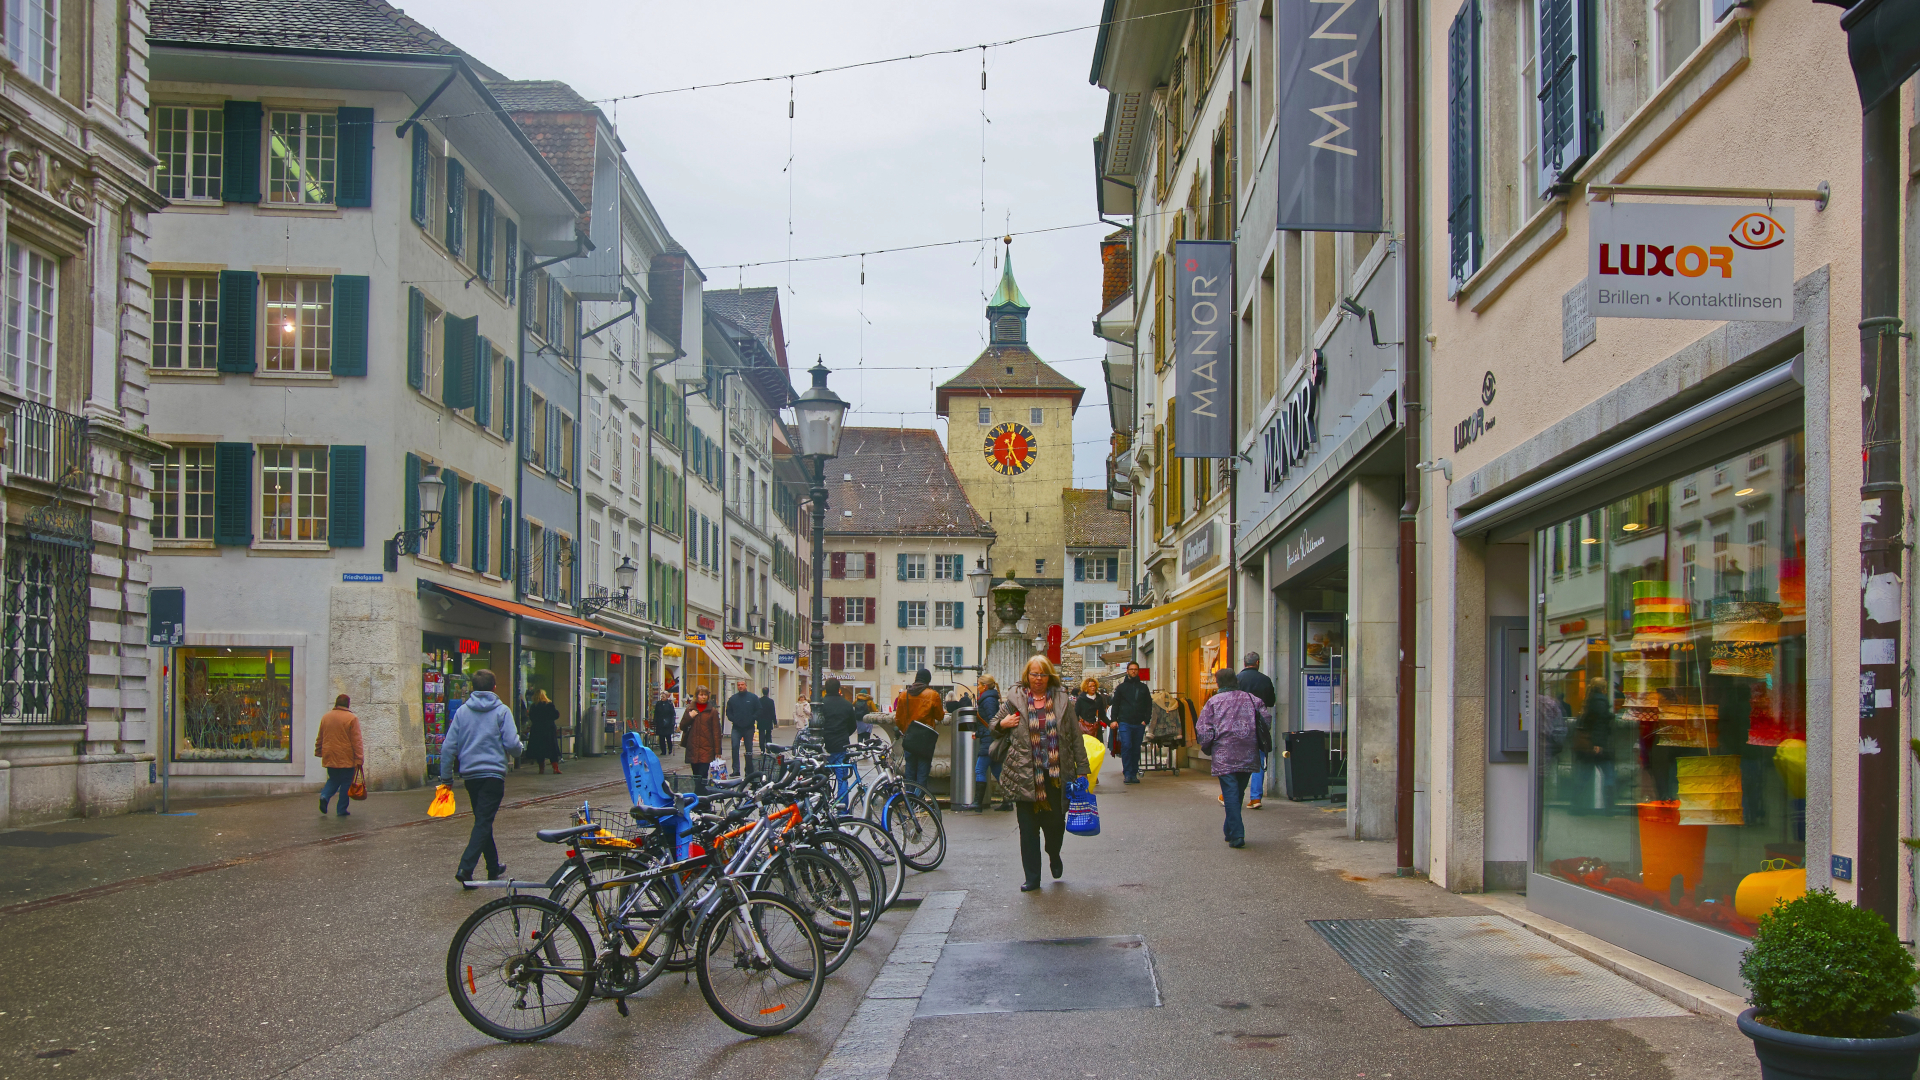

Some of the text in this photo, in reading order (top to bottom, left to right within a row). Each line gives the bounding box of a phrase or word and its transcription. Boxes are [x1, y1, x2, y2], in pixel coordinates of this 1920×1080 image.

[1599, 243, 1734, 278] LUXOR
[1598, 289, 1782, 308] Brillen Kontaktlinsen
[1191, 275, 1218, 418] MANOR
[1264, 378, 1317, 493] MANOR
[1454, 407, 1484, 453] LUXOR
[1186, 530, 1209, 566] Clochard
[754, 641, 771, 650] WE
[640, 867, 663, 878] FUEL
